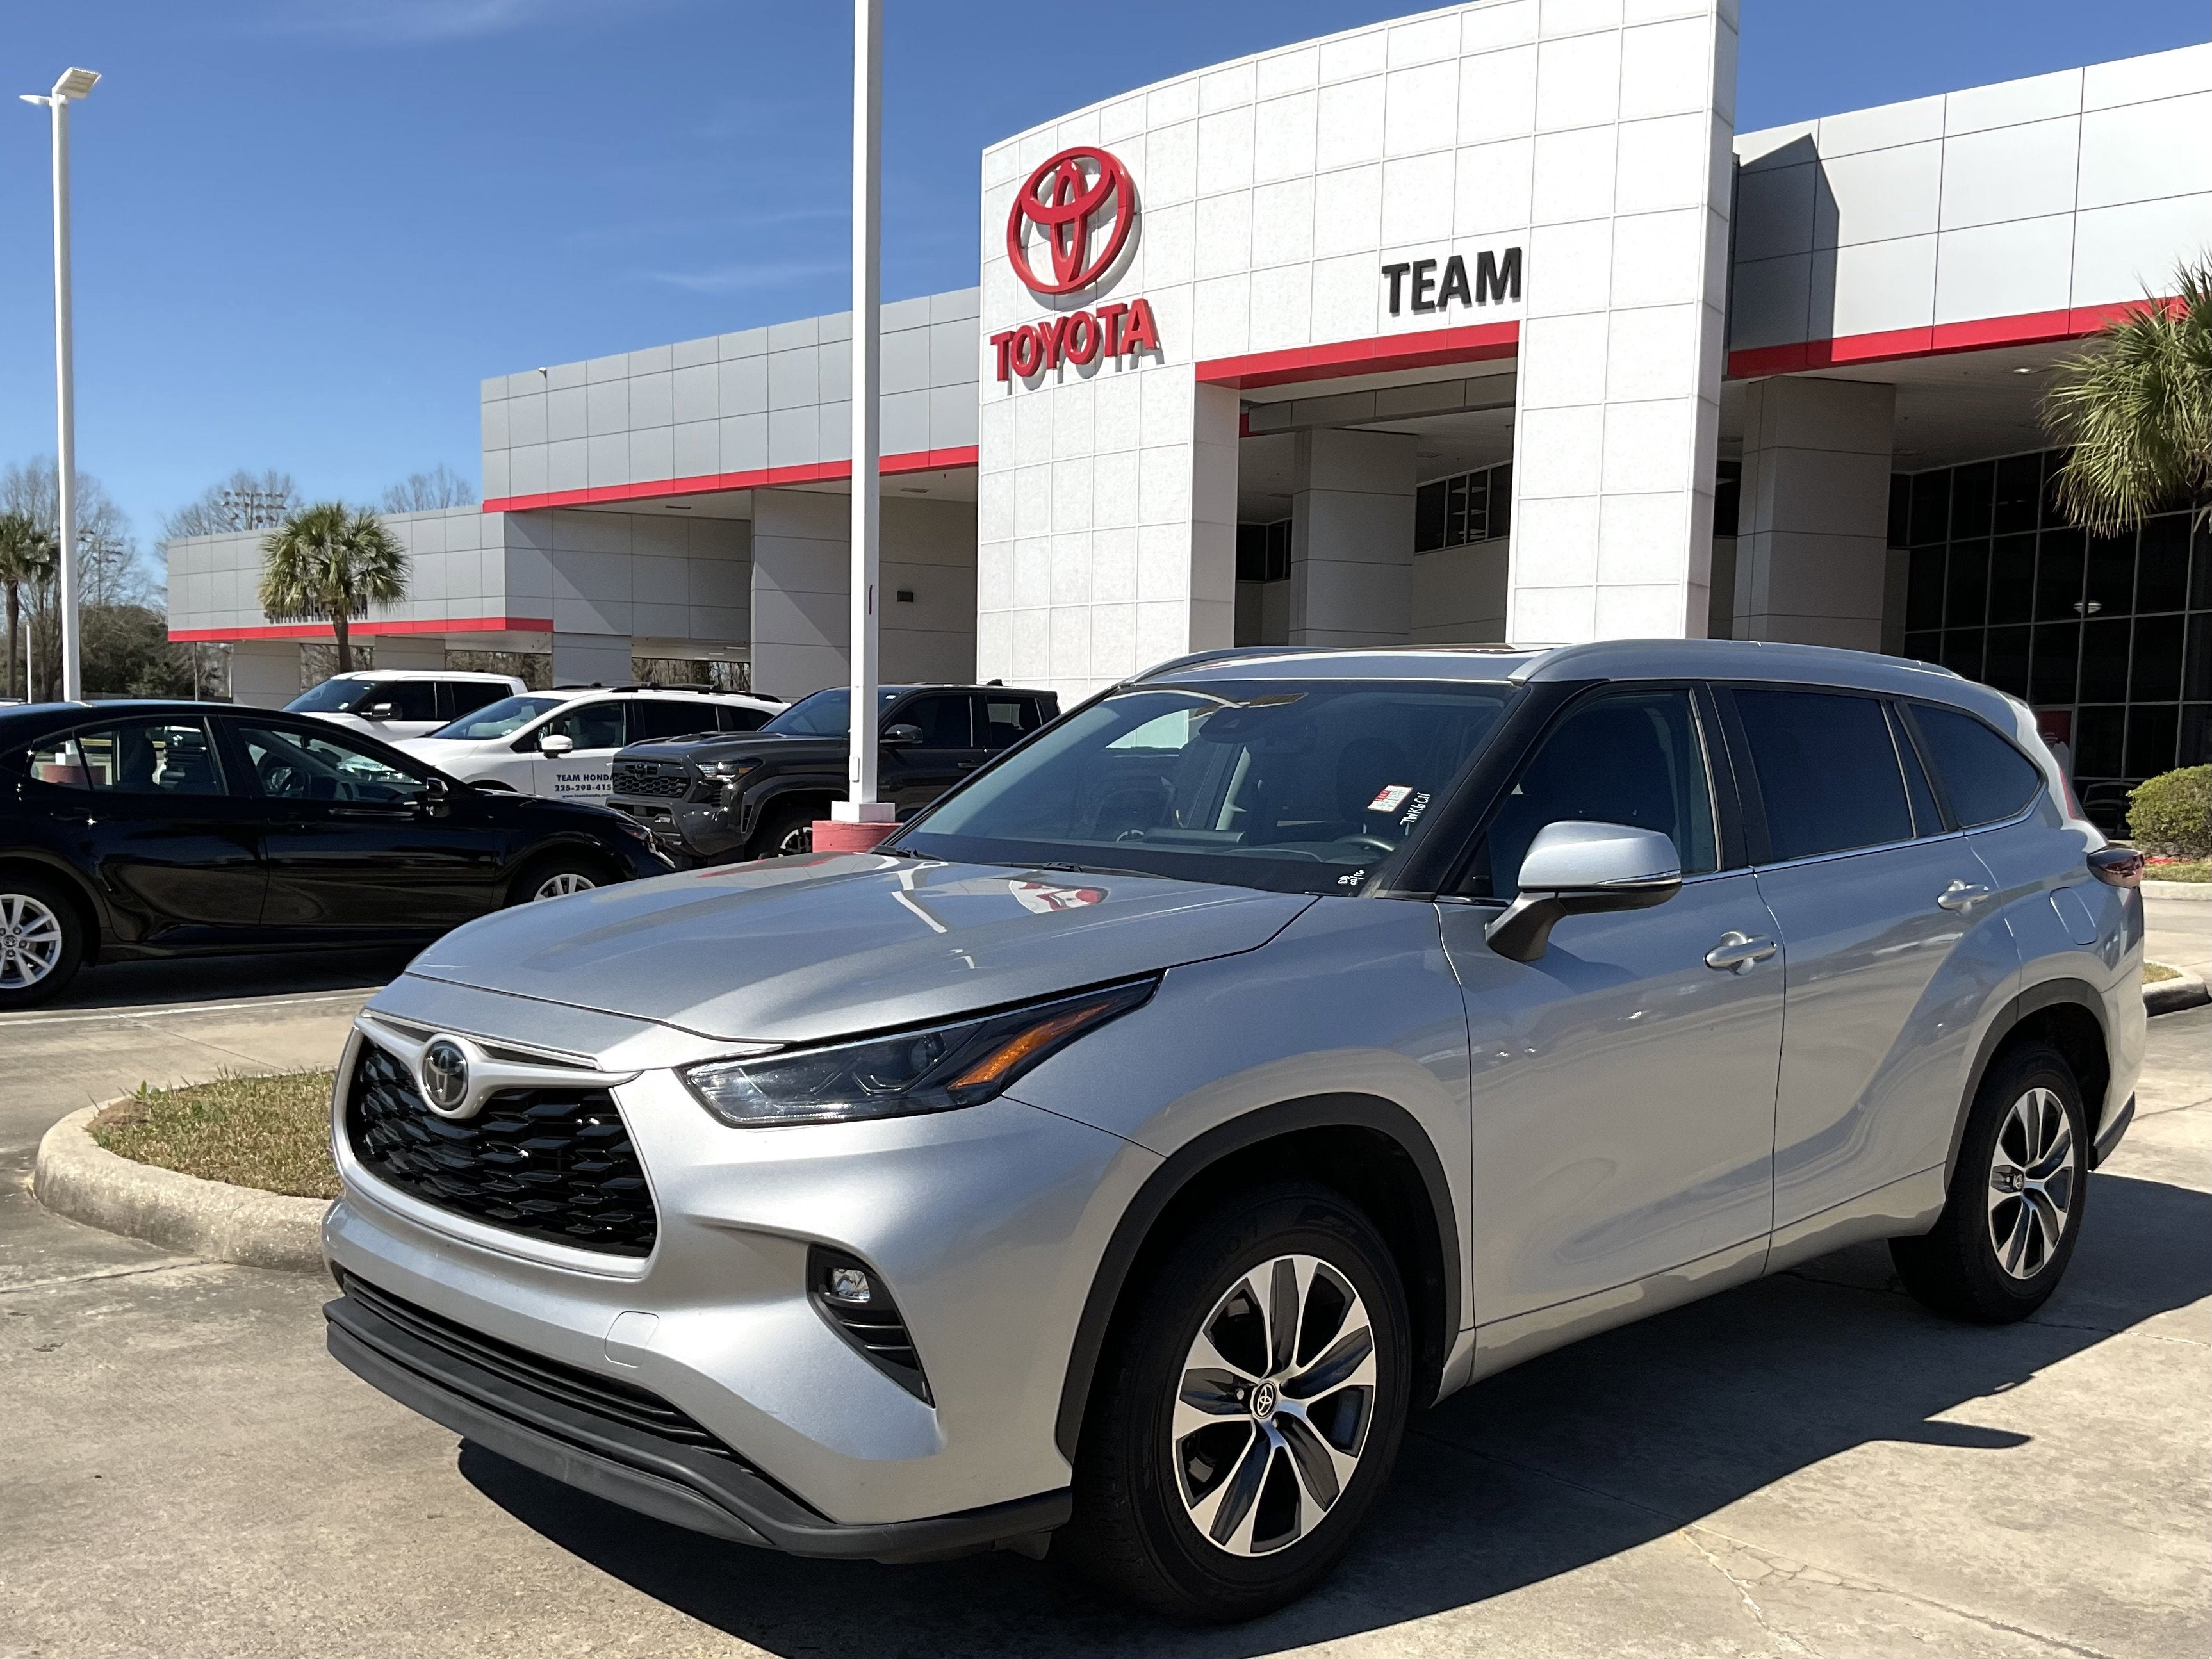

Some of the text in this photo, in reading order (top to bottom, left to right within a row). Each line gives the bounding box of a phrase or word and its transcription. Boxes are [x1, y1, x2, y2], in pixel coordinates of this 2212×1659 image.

[1381, 246, 1522, 314] TEAM
[990, 298, 1158, 382] TOYOTA
[554, 783, 612, 792] 225-298-415
